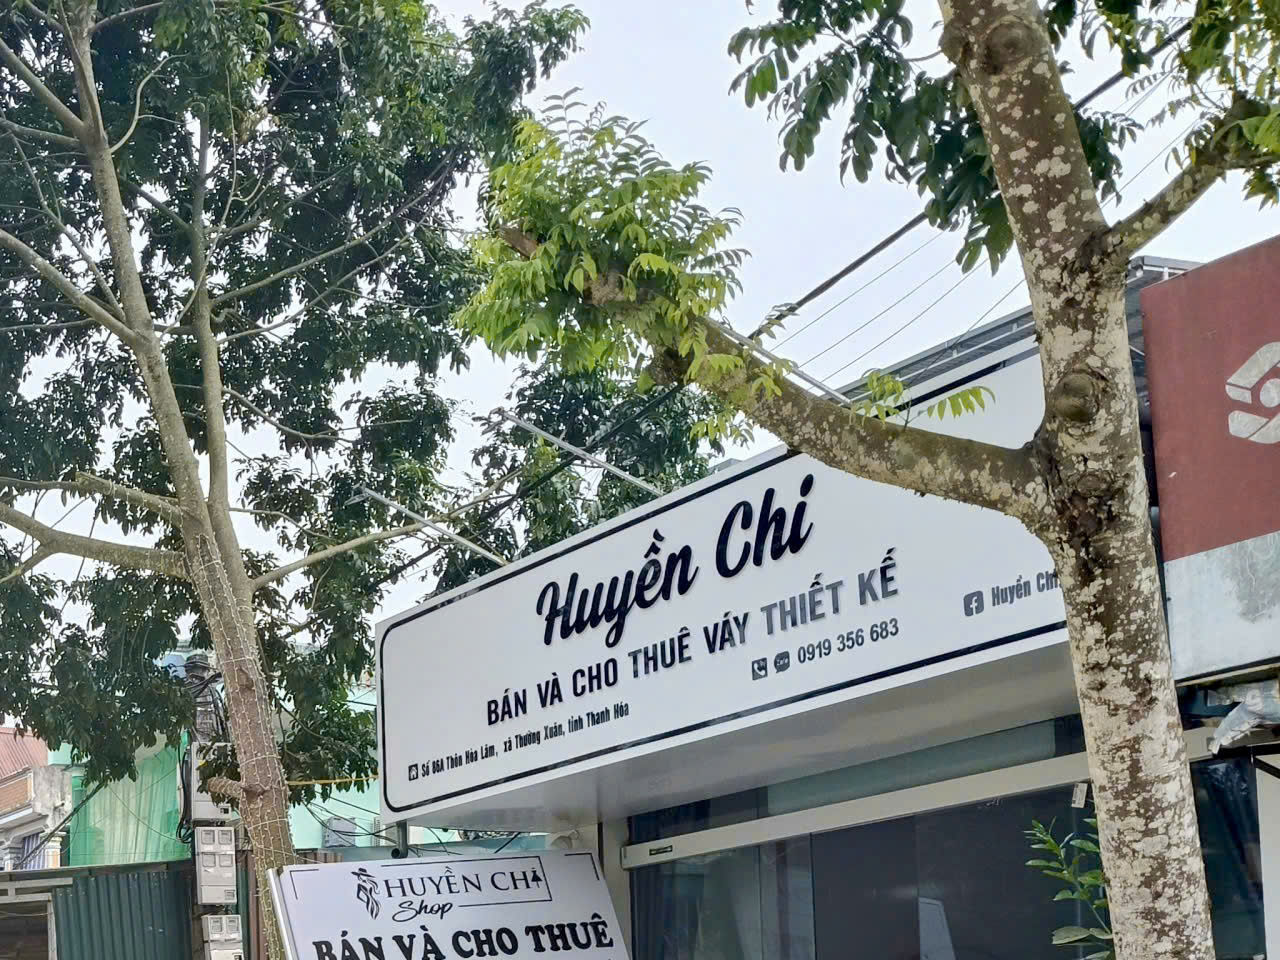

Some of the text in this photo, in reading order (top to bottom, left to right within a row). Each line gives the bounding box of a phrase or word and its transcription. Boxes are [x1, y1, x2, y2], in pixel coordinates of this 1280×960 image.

[536, 474, 814, 648] Huyền Chi
[486, 547, 898, 726] BÁN VÀ CHO THUÊ VÁY THIẾT KẾ
[797, 638, 832, 664] 0919
[836, 628, 865, 653] 356
[870, 618, 900, 643] 683
[421, 760, 431, 778] Số
[446, 751, 463, 770] Thôn
[465, 747, 478, 765] Hòa
[514, 729, 541, 749] Thường
[586, 706, 610, 728] Thanh
[613, 700, 630, 719] Hóa
[383, 865, 483, 898] HUYỀN
[391, 898, 454, 923] Shop
[451, 927, 519, 959] CHO
[524, 912, 615, 953] THUÊ
